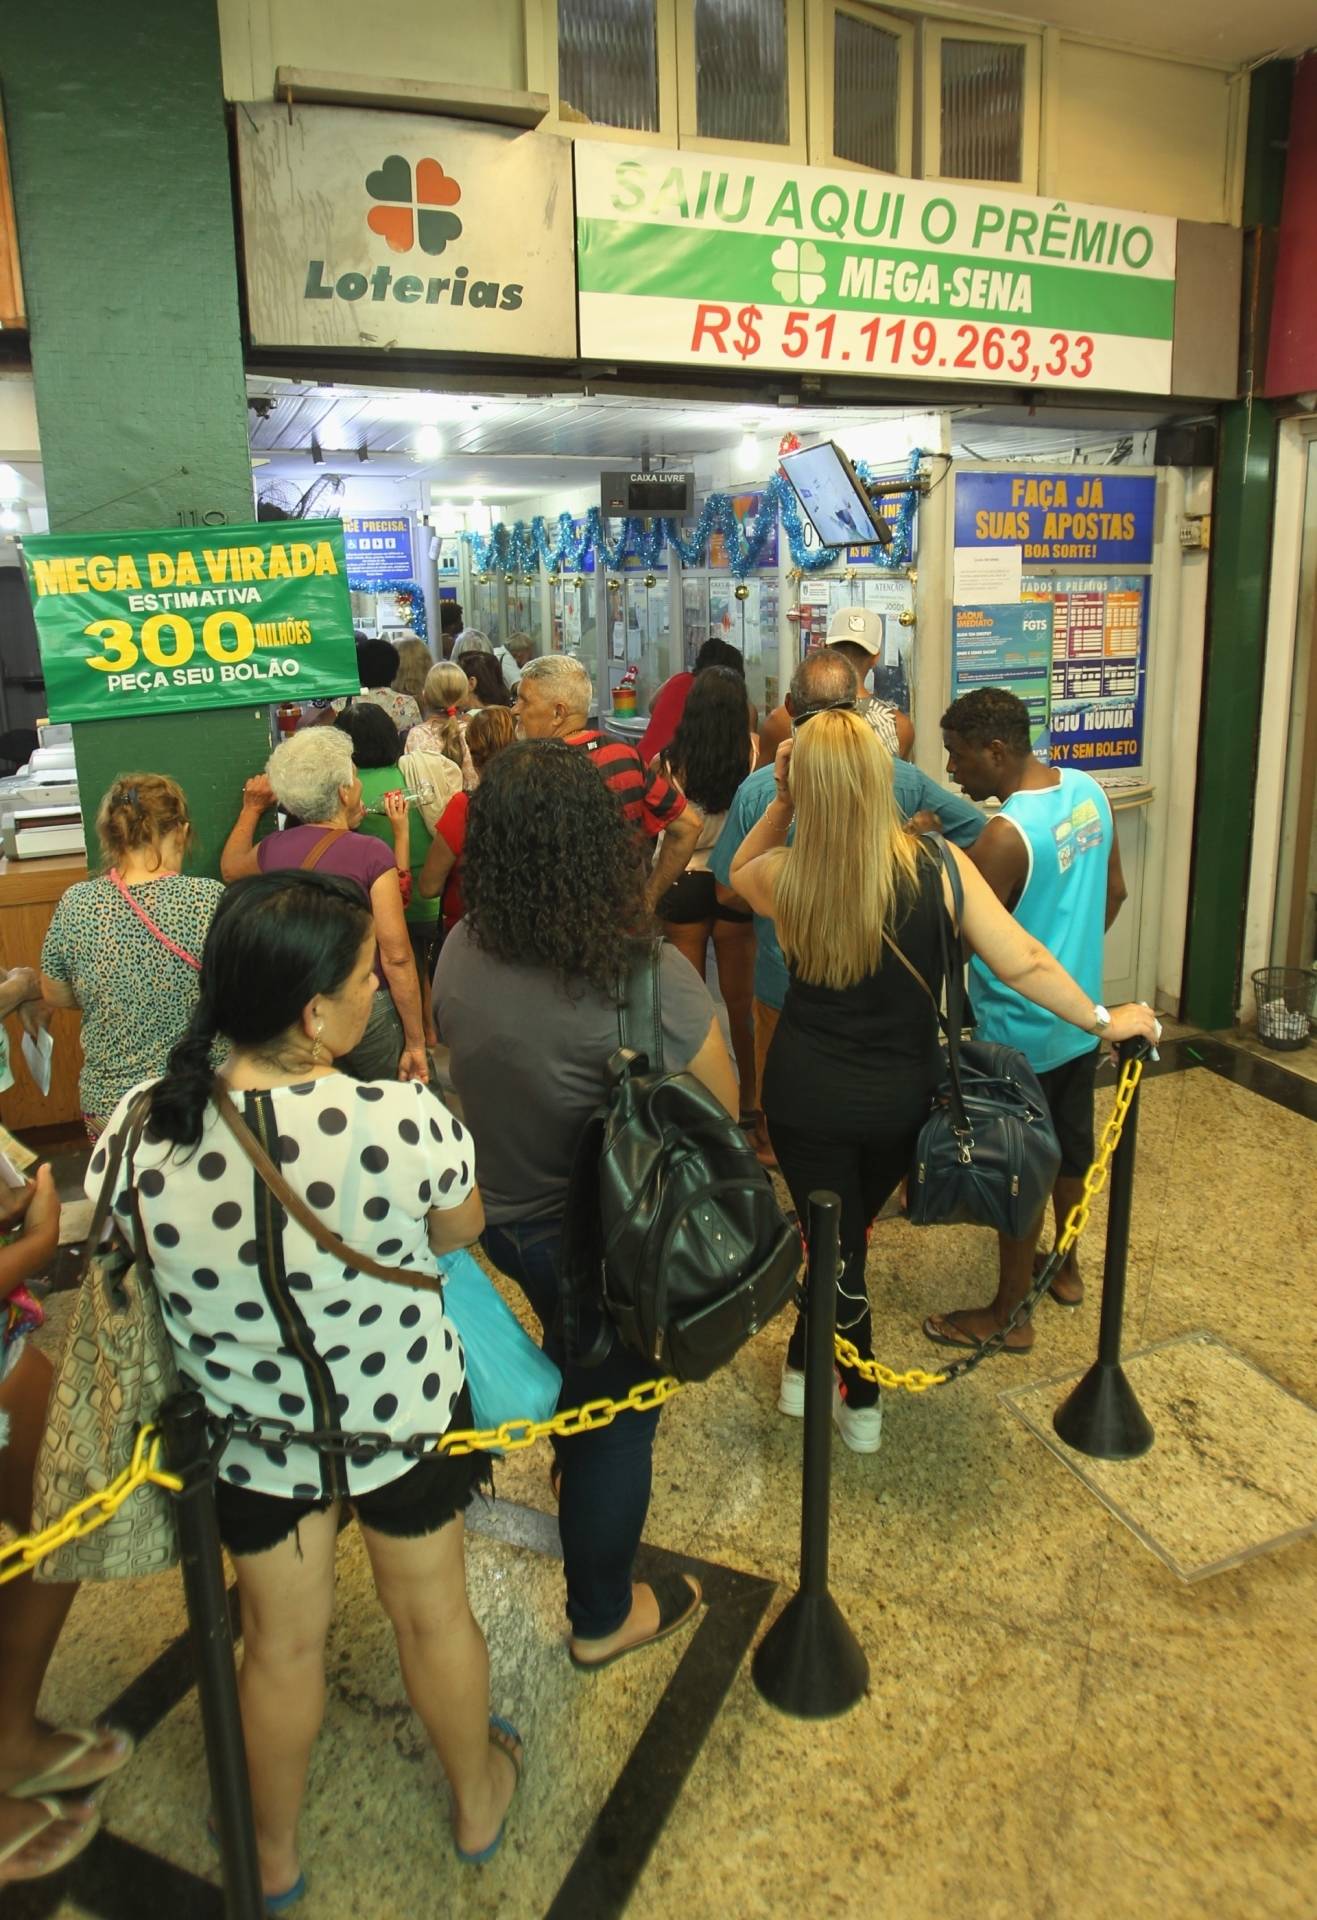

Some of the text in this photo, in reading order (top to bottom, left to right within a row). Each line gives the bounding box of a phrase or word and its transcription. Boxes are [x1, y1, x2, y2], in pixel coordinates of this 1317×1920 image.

[611, 161, 1154, 269] SAIU AQUI O PRÊMIO
[304, 261, 523, 311] Loterias
[838, 256, 1033, 314] MEGA-SENA
[691, 304, 1095, 382] R$ 51.119.263,33
[631, 474, 685, 482] CAIXA LIVRE
[1012, 477, 1104, 512] FAÇA JÁ
[976, 511, 1136, 541] SUAS APOSTAS
[1024, 544, 1097, 558] BOA SORTE!
[34, 541, 338, 597] MEGA DA VIRADA
[128, 587, 262, 612] ESTIMATIVA
[1020, 582, 1053, 592] TADOS
[84, 610, 312, 672] 300 MILHÕES
[1023, 620, 1047, 631] FGTS
[108, 658, 300, 693] PEÇA SEU BOLÃO
[1049, 740, 1137, 760] SKY SEM BOLETO
